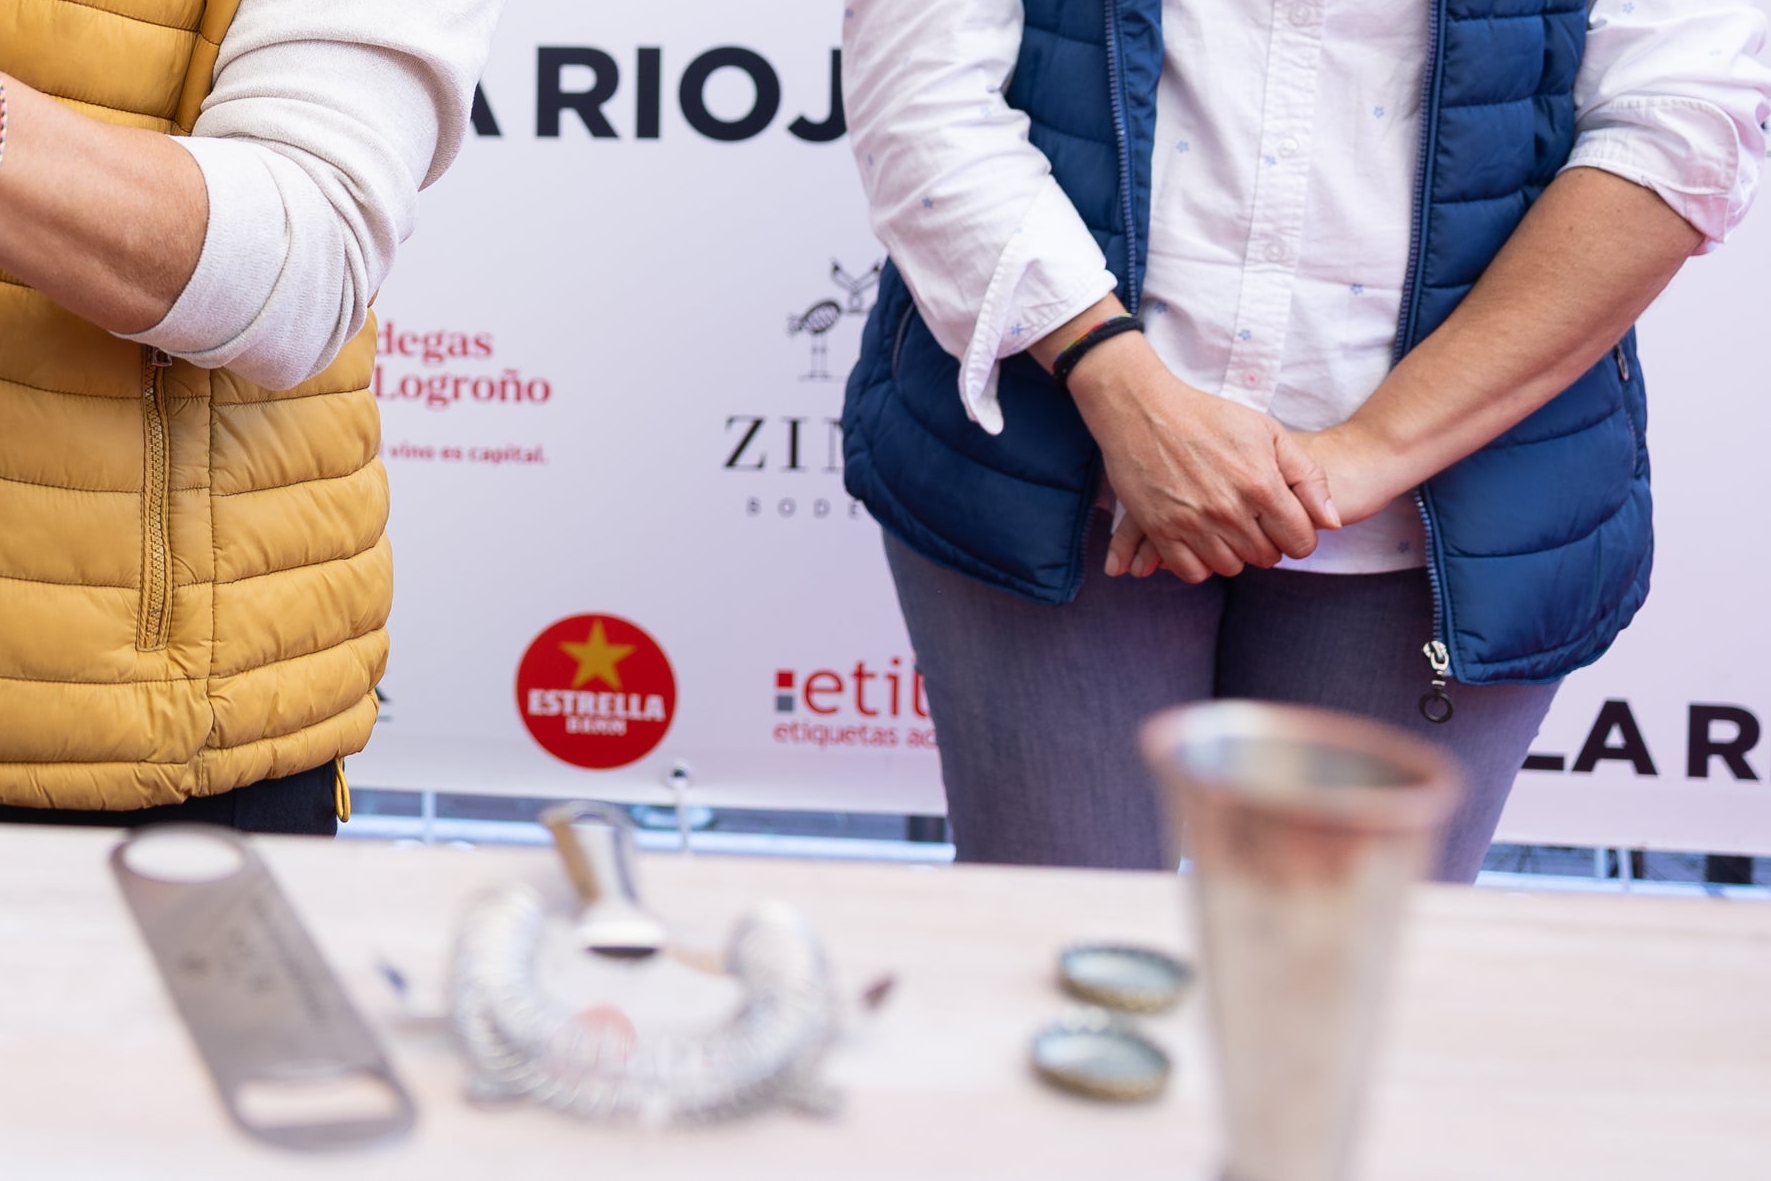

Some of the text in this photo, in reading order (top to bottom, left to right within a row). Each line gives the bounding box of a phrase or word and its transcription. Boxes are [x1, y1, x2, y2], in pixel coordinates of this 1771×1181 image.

[535, 46, 848, 144] RIOJ
[374, 365, 552, 409] Logroño
[529, 689, 665, 721] ESTRELLA
[774, 722, 899, 748] etiquetas
